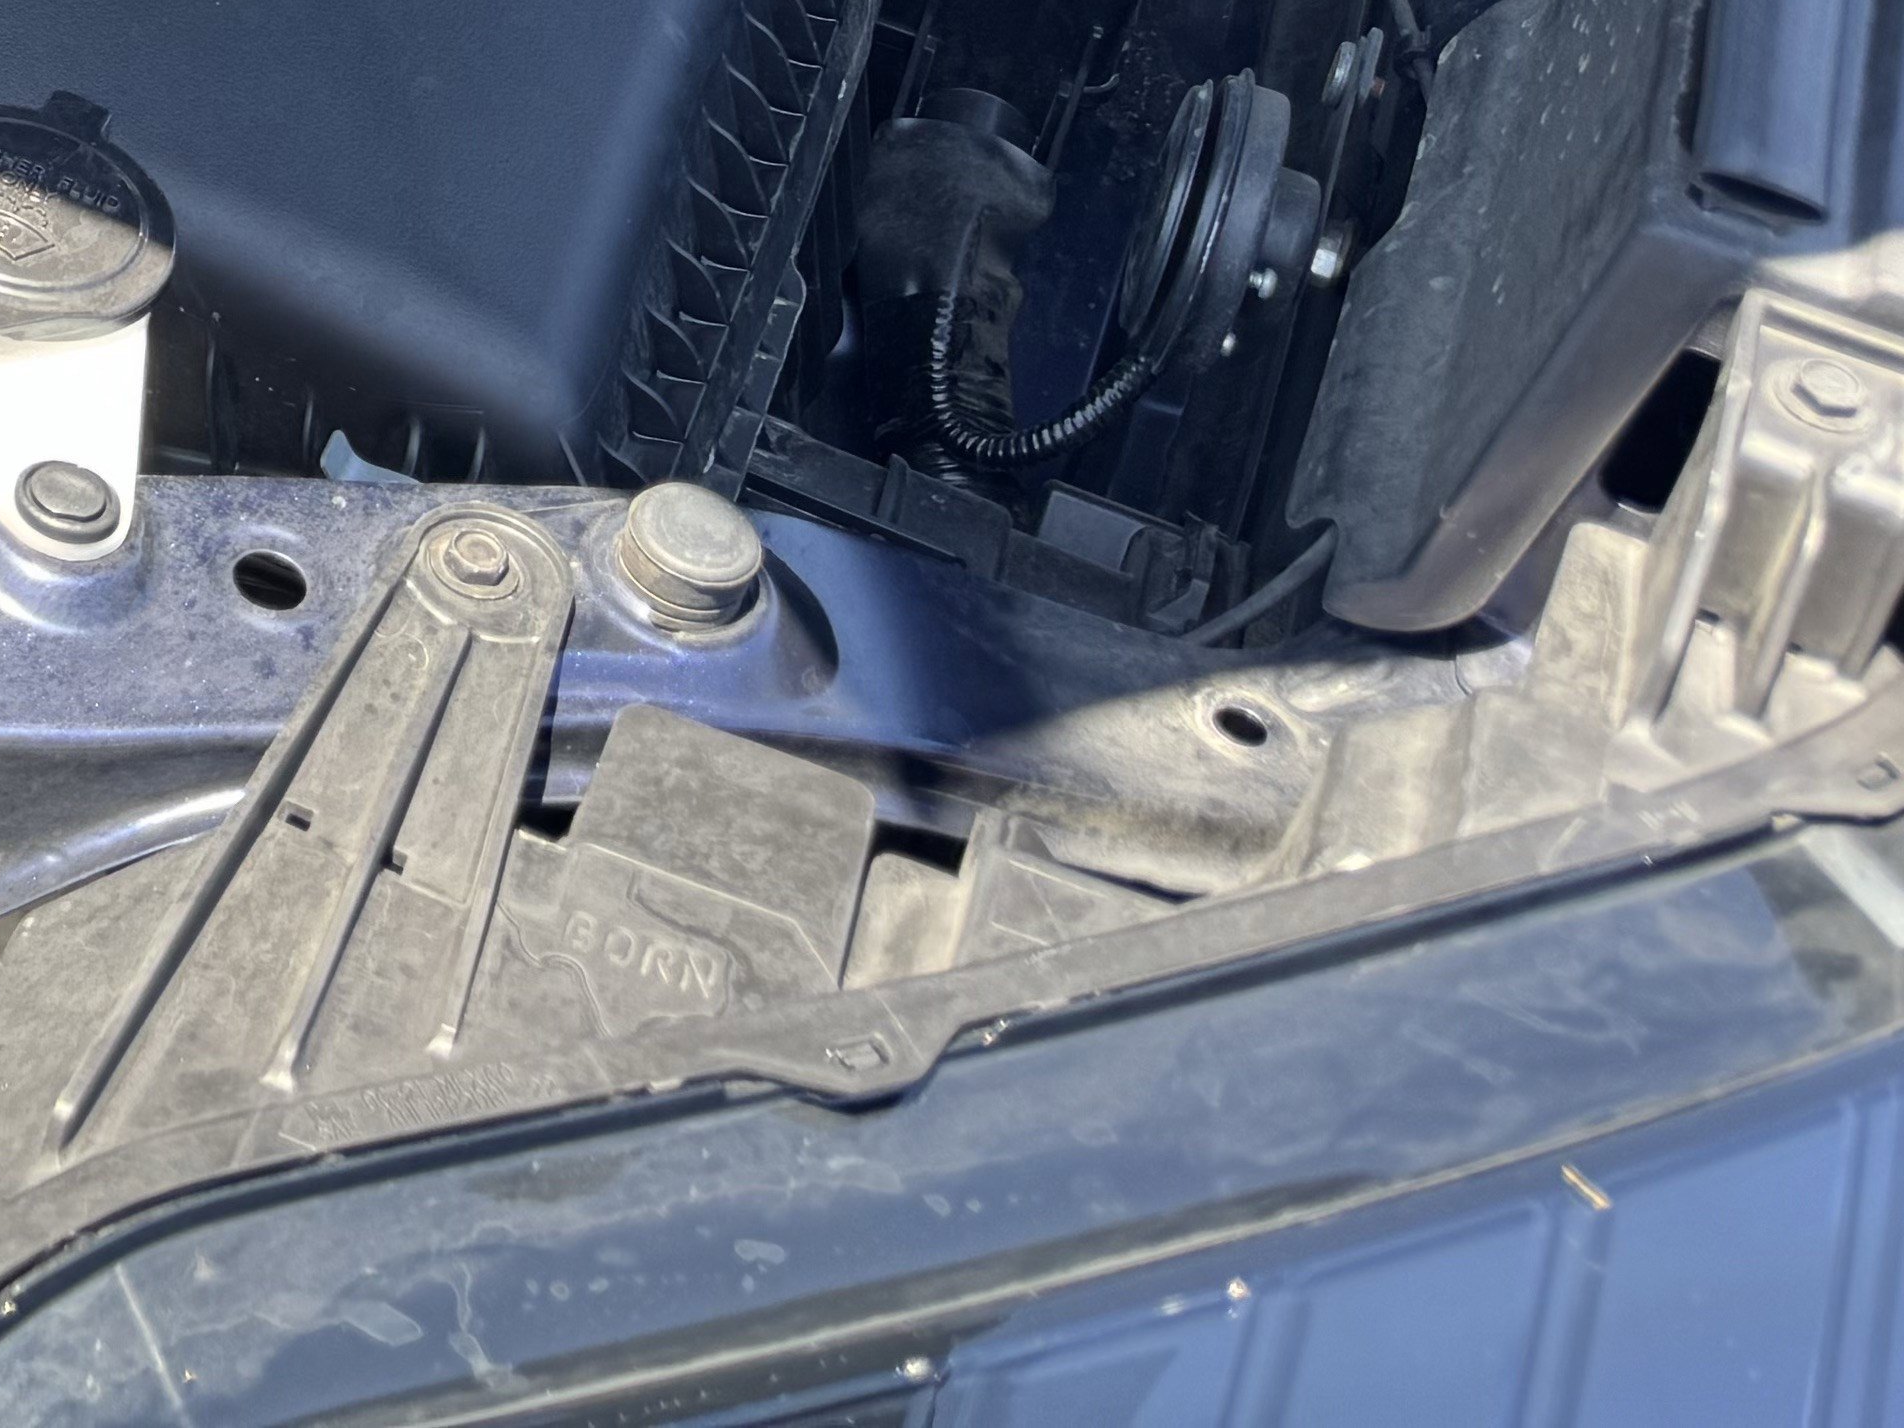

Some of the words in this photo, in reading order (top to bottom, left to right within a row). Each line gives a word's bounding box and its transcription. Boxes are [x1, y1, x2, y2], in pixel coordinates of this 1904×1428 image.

[0, 170, 59, 205] ONLY
[57, 175, 122, 215] FLUID
[563, 909, 729, 1001] BORN
